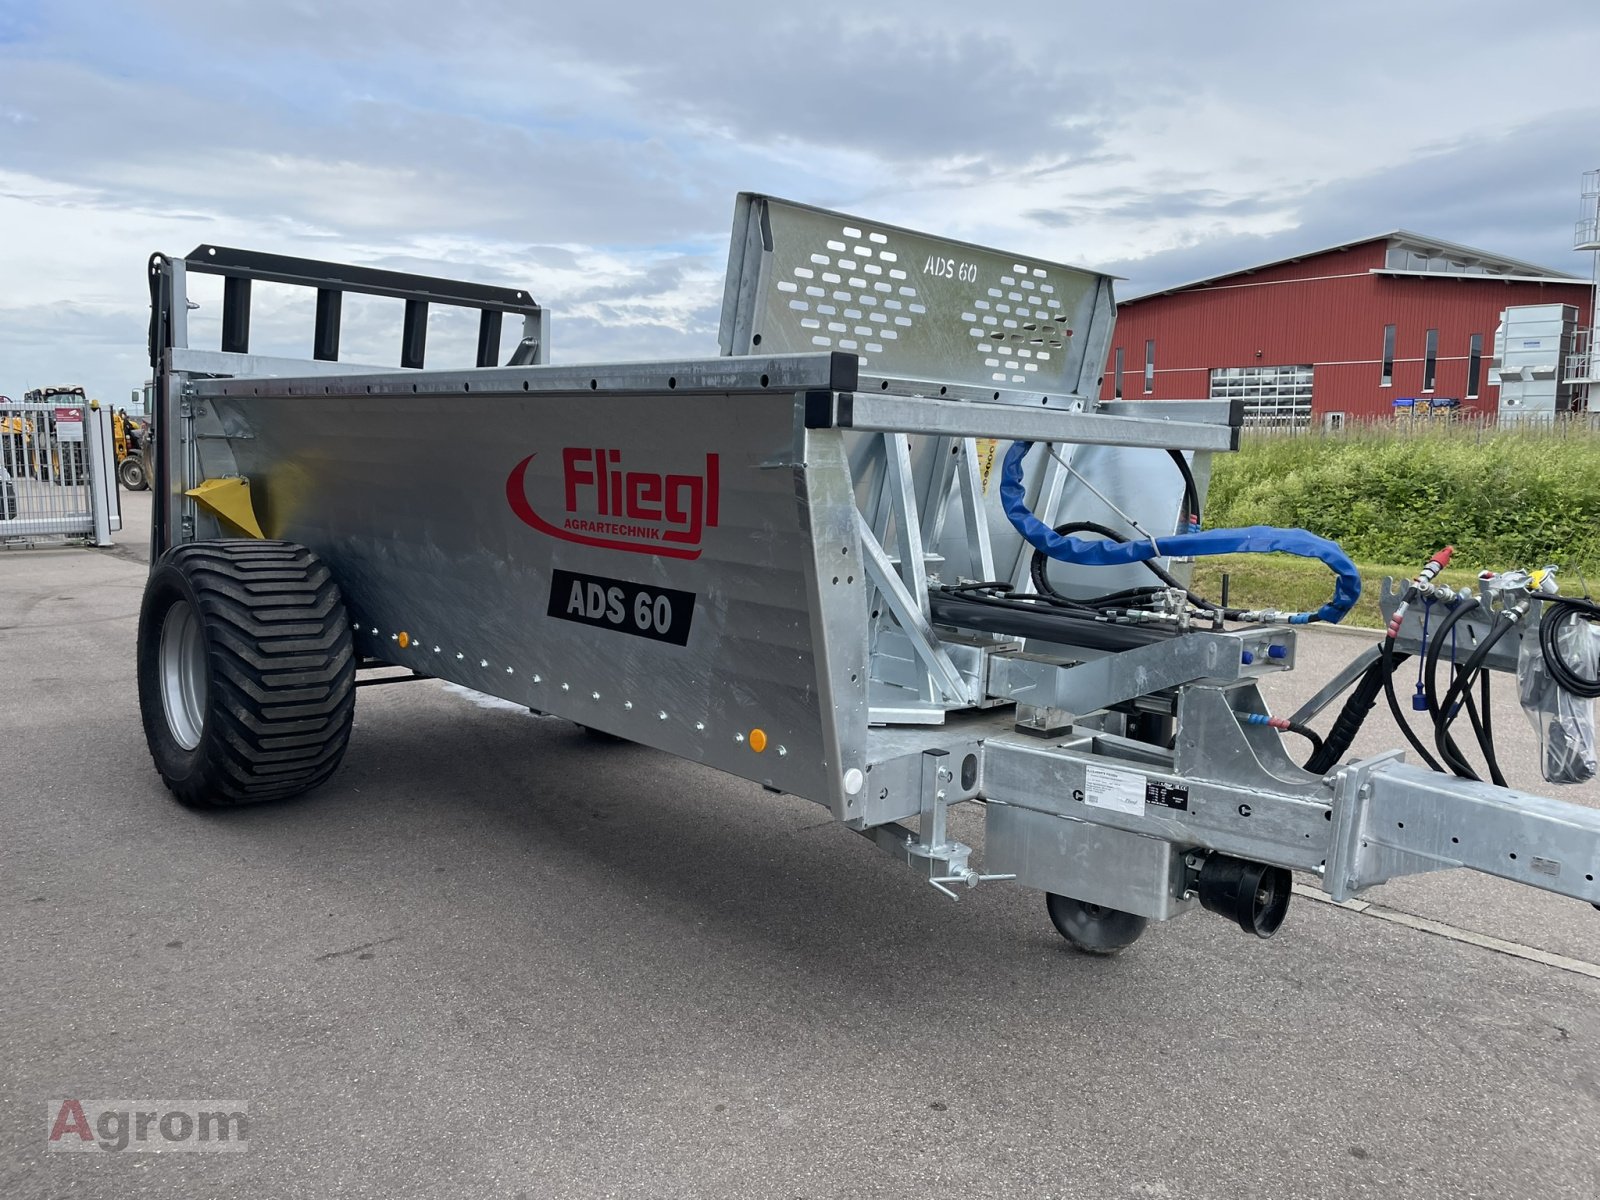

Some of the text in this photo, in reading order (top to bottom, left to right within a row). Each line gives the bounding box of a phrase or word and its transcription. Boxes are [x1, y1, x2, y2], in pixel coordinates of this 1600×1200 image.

[923, 255, 978, 283] ADS 60
[562, 447, 720, 545] Fliegl
[564, 518, 660, 540] AGRARTECHNIK
[566, 580, 672, 634] ADS 60
